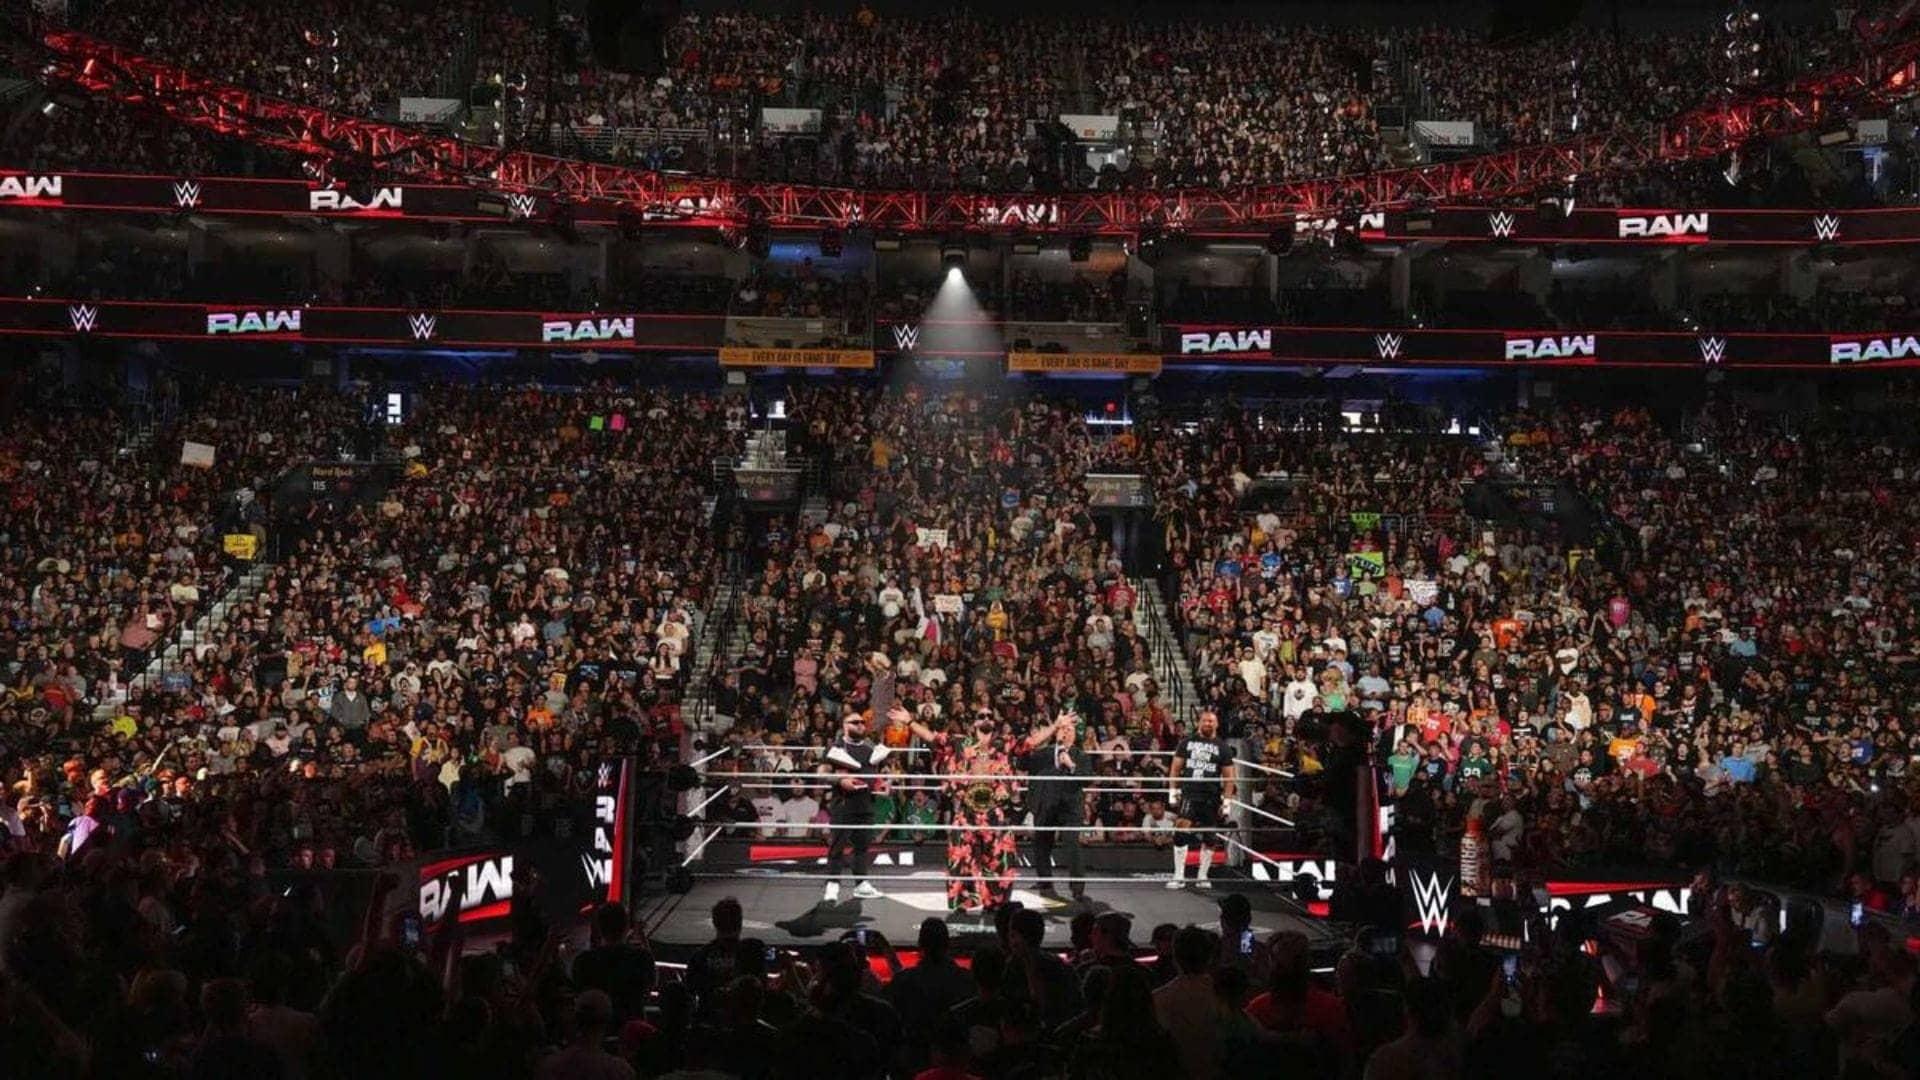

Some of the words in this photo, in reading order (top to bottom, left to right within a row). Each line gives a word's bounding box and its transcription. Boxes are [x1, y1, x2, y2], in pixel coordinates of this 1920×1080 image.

[0, 176, 62, 198] AW
[1619, 213, 1709, 238] RAW
[207, 310, 301, 335] RAW
[542, 317, 635, 342] RAW
[1181, 329, 1272, 354] RAW
[1505, 334, 1596, 360] RAW
[1830, 335, 1920, 364] RAW
[752, 351, 776, 363] EVERY
[777, 351, 791, 363] DAY
[1041, 356, 1065, 368] EVERY
